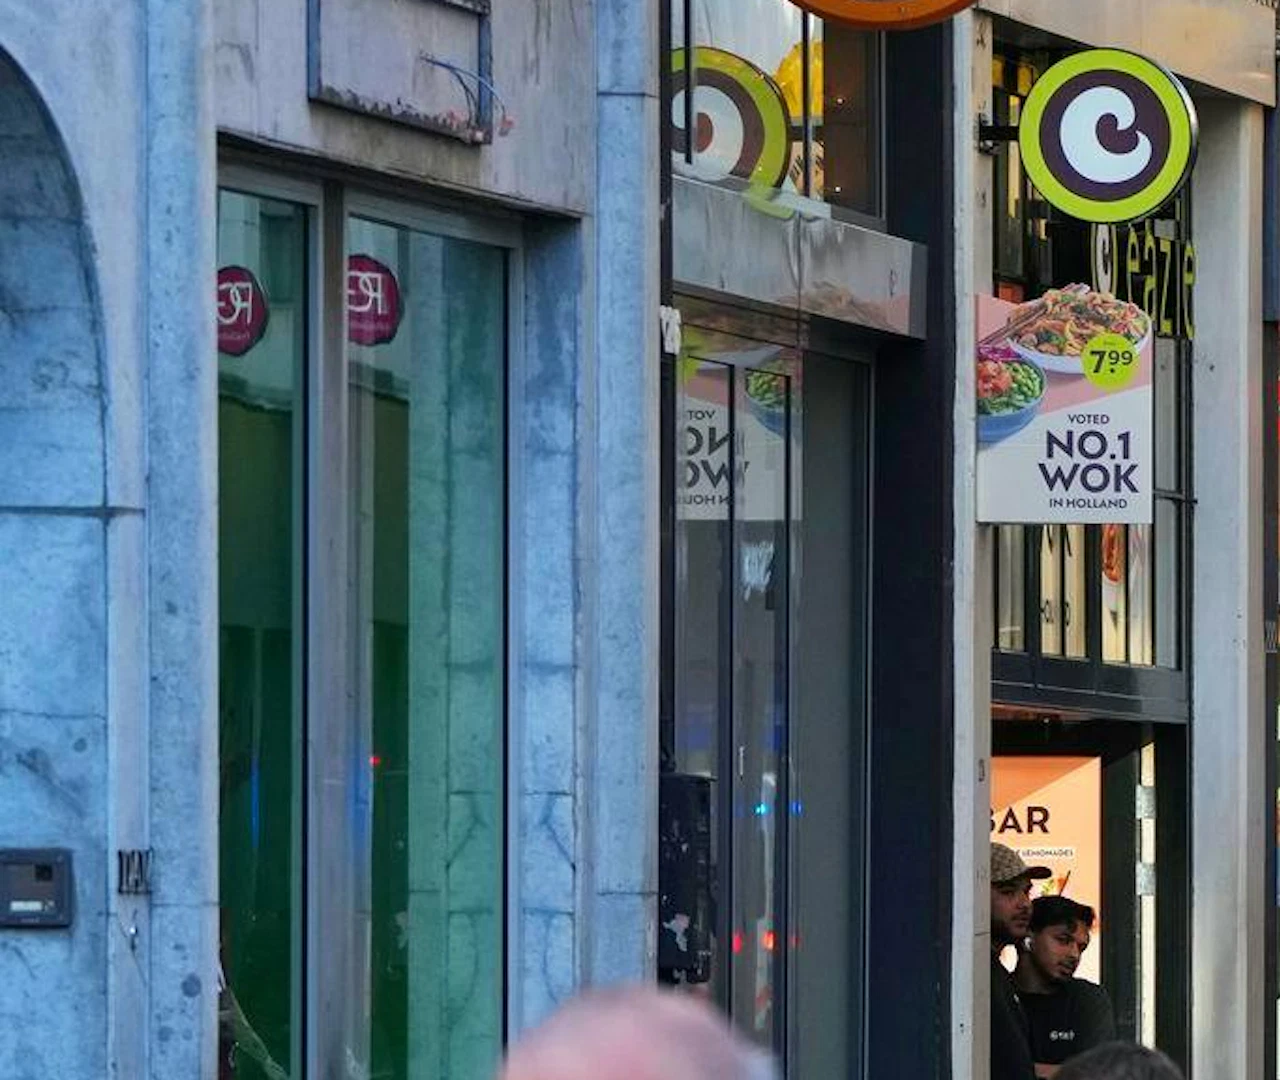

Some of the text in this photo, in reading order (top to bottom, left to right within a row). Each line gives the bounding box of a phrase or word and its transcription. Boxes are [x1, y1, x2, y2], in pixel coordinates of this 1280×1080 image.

[1068, 414, 1110, 425] VOTED
[1046, 430, 1131, 460] NO.1
[1038, 463, 1139, 494] WOK
[1050, 499, 1128, 509] IN HOLLAND
